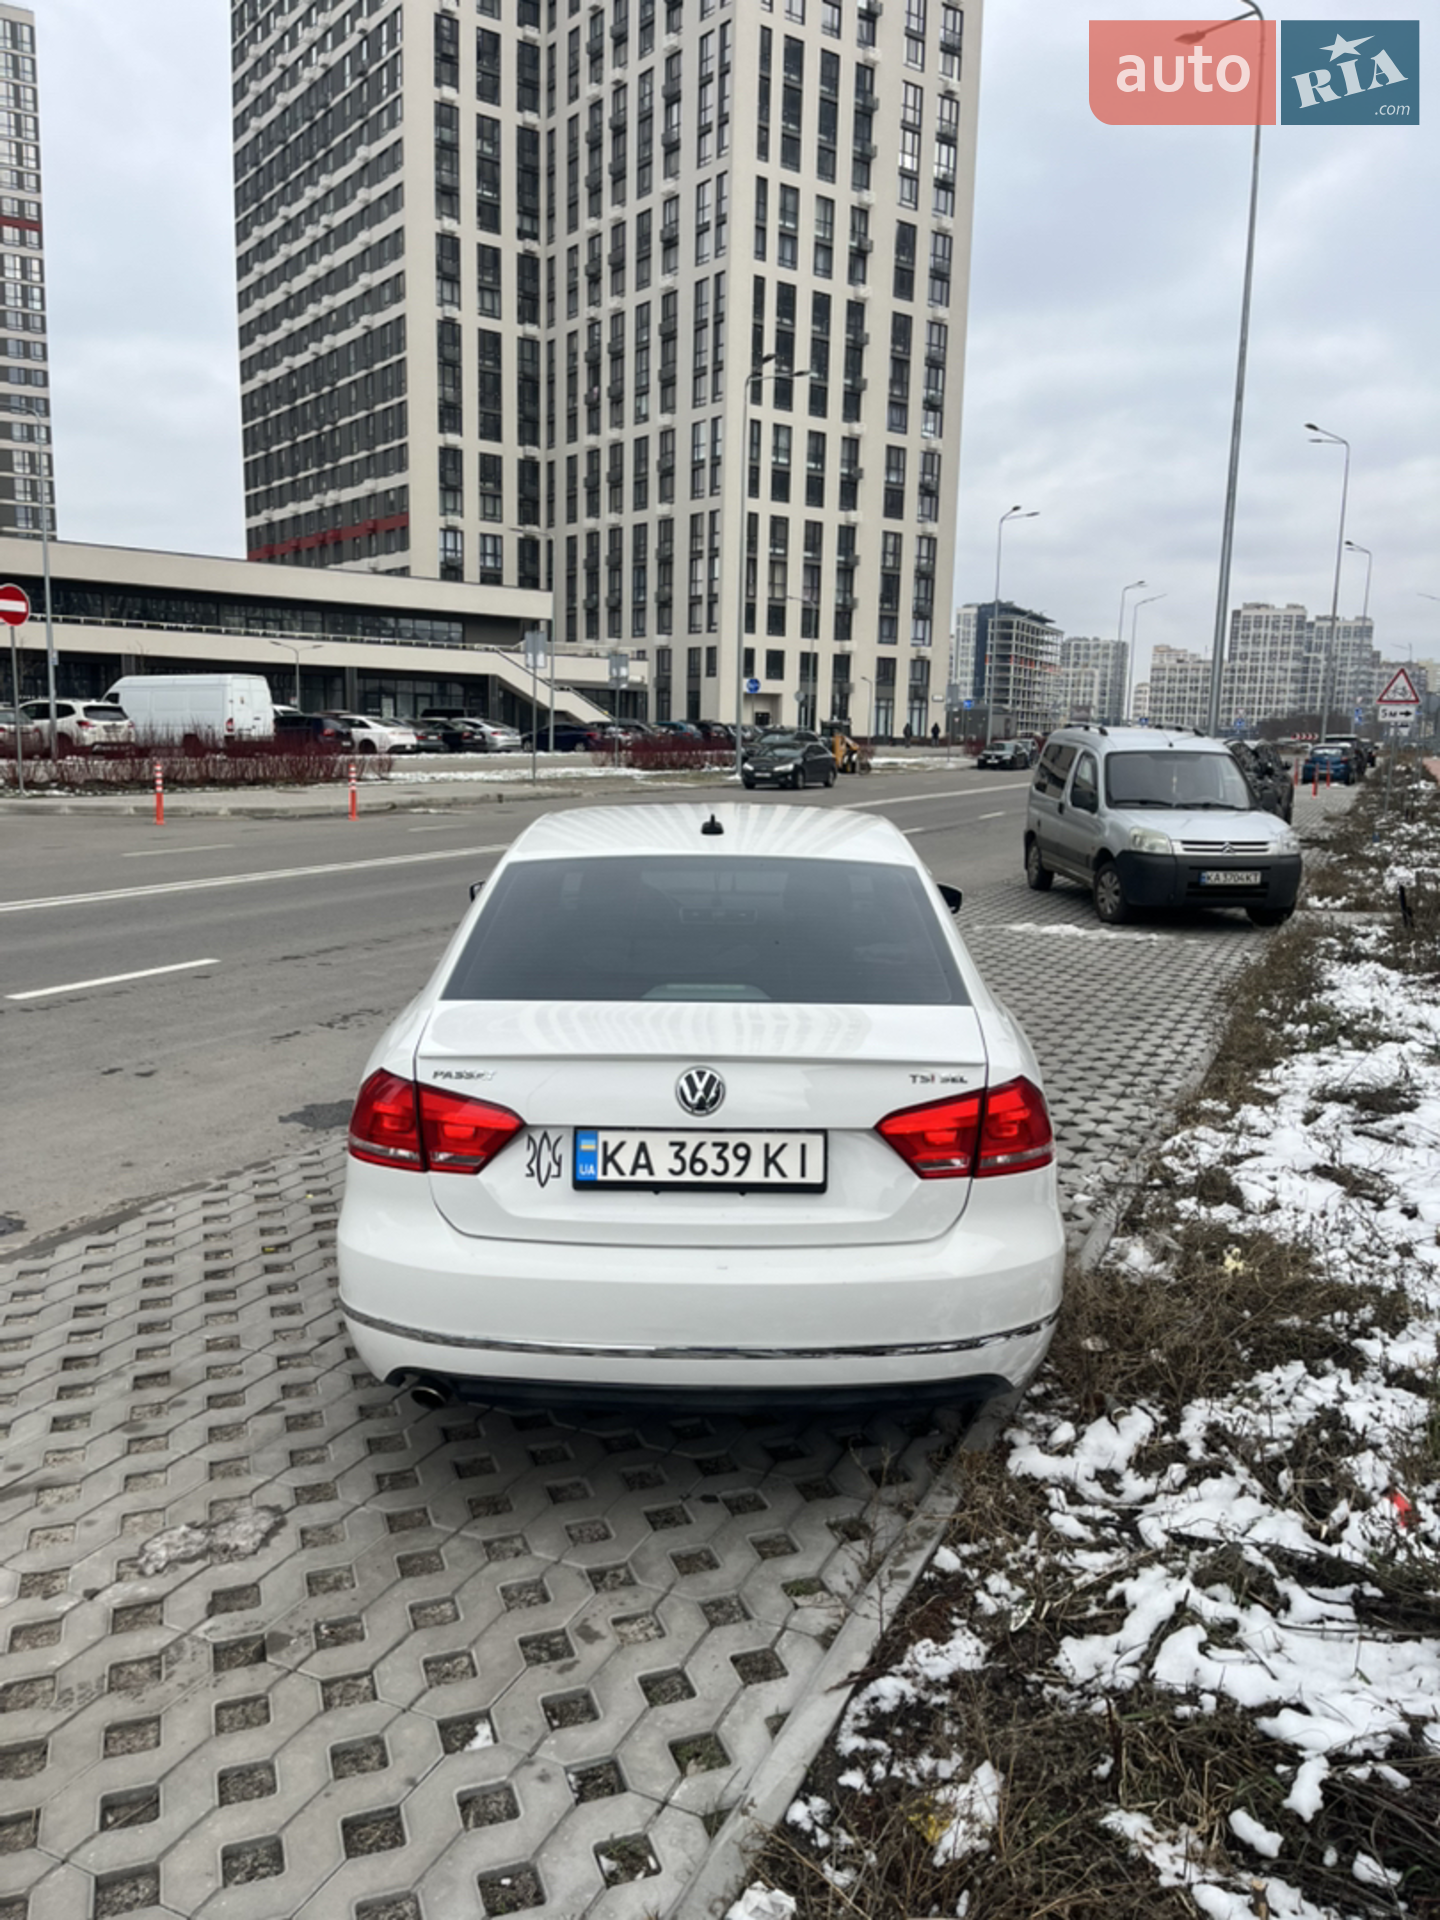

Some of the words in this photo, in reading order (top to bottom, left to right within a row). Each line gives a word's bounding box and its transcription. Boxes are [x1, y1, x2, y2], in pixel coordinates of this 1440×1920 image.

[579, 1165, 596, 1176] UA
[602, 1140, 655, 1177] KA
[668, 1140, 752, 1178] 3639
